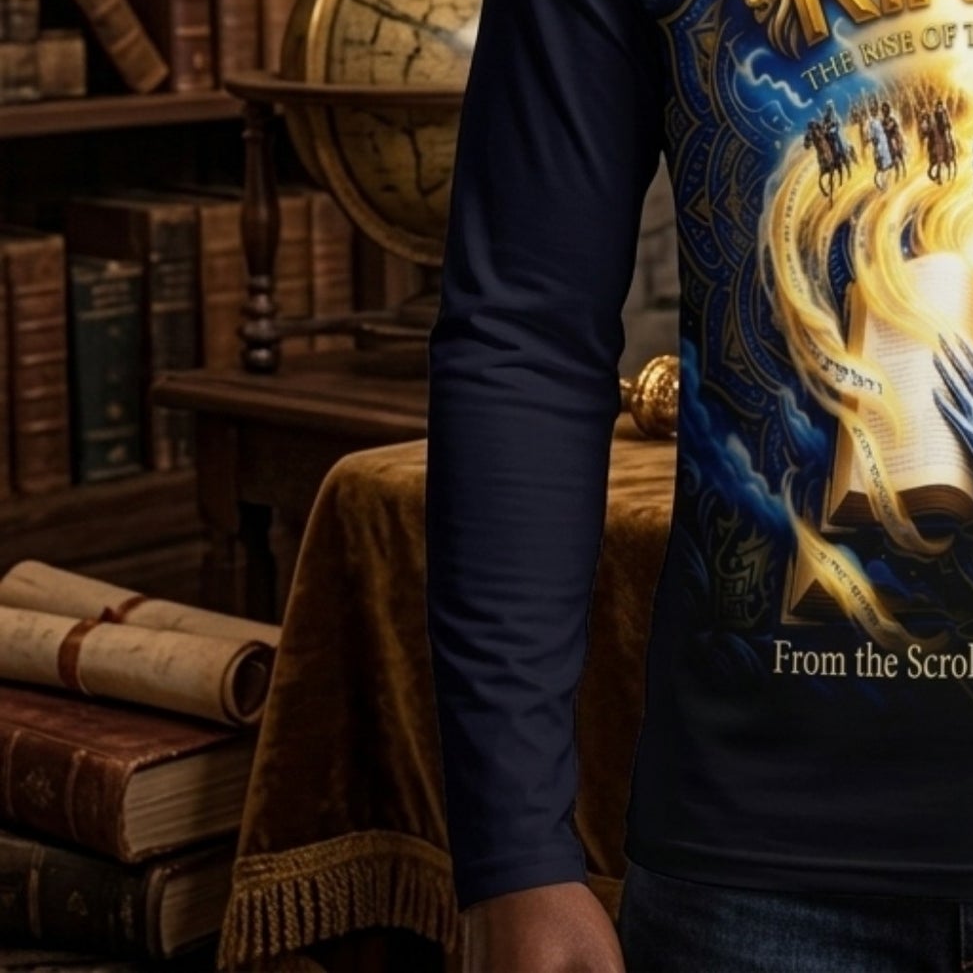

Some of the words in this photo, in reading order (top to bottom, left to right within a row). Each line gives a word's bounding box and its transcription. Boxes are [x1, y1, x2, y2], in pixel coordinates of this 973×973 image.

[800, 49, 856, 91] THE
[859, 30, 916, 67] RISE
[921, 23, 957, 51] OF
[773, 640, 846, 676] From
[855, 642, 898, 678] the
